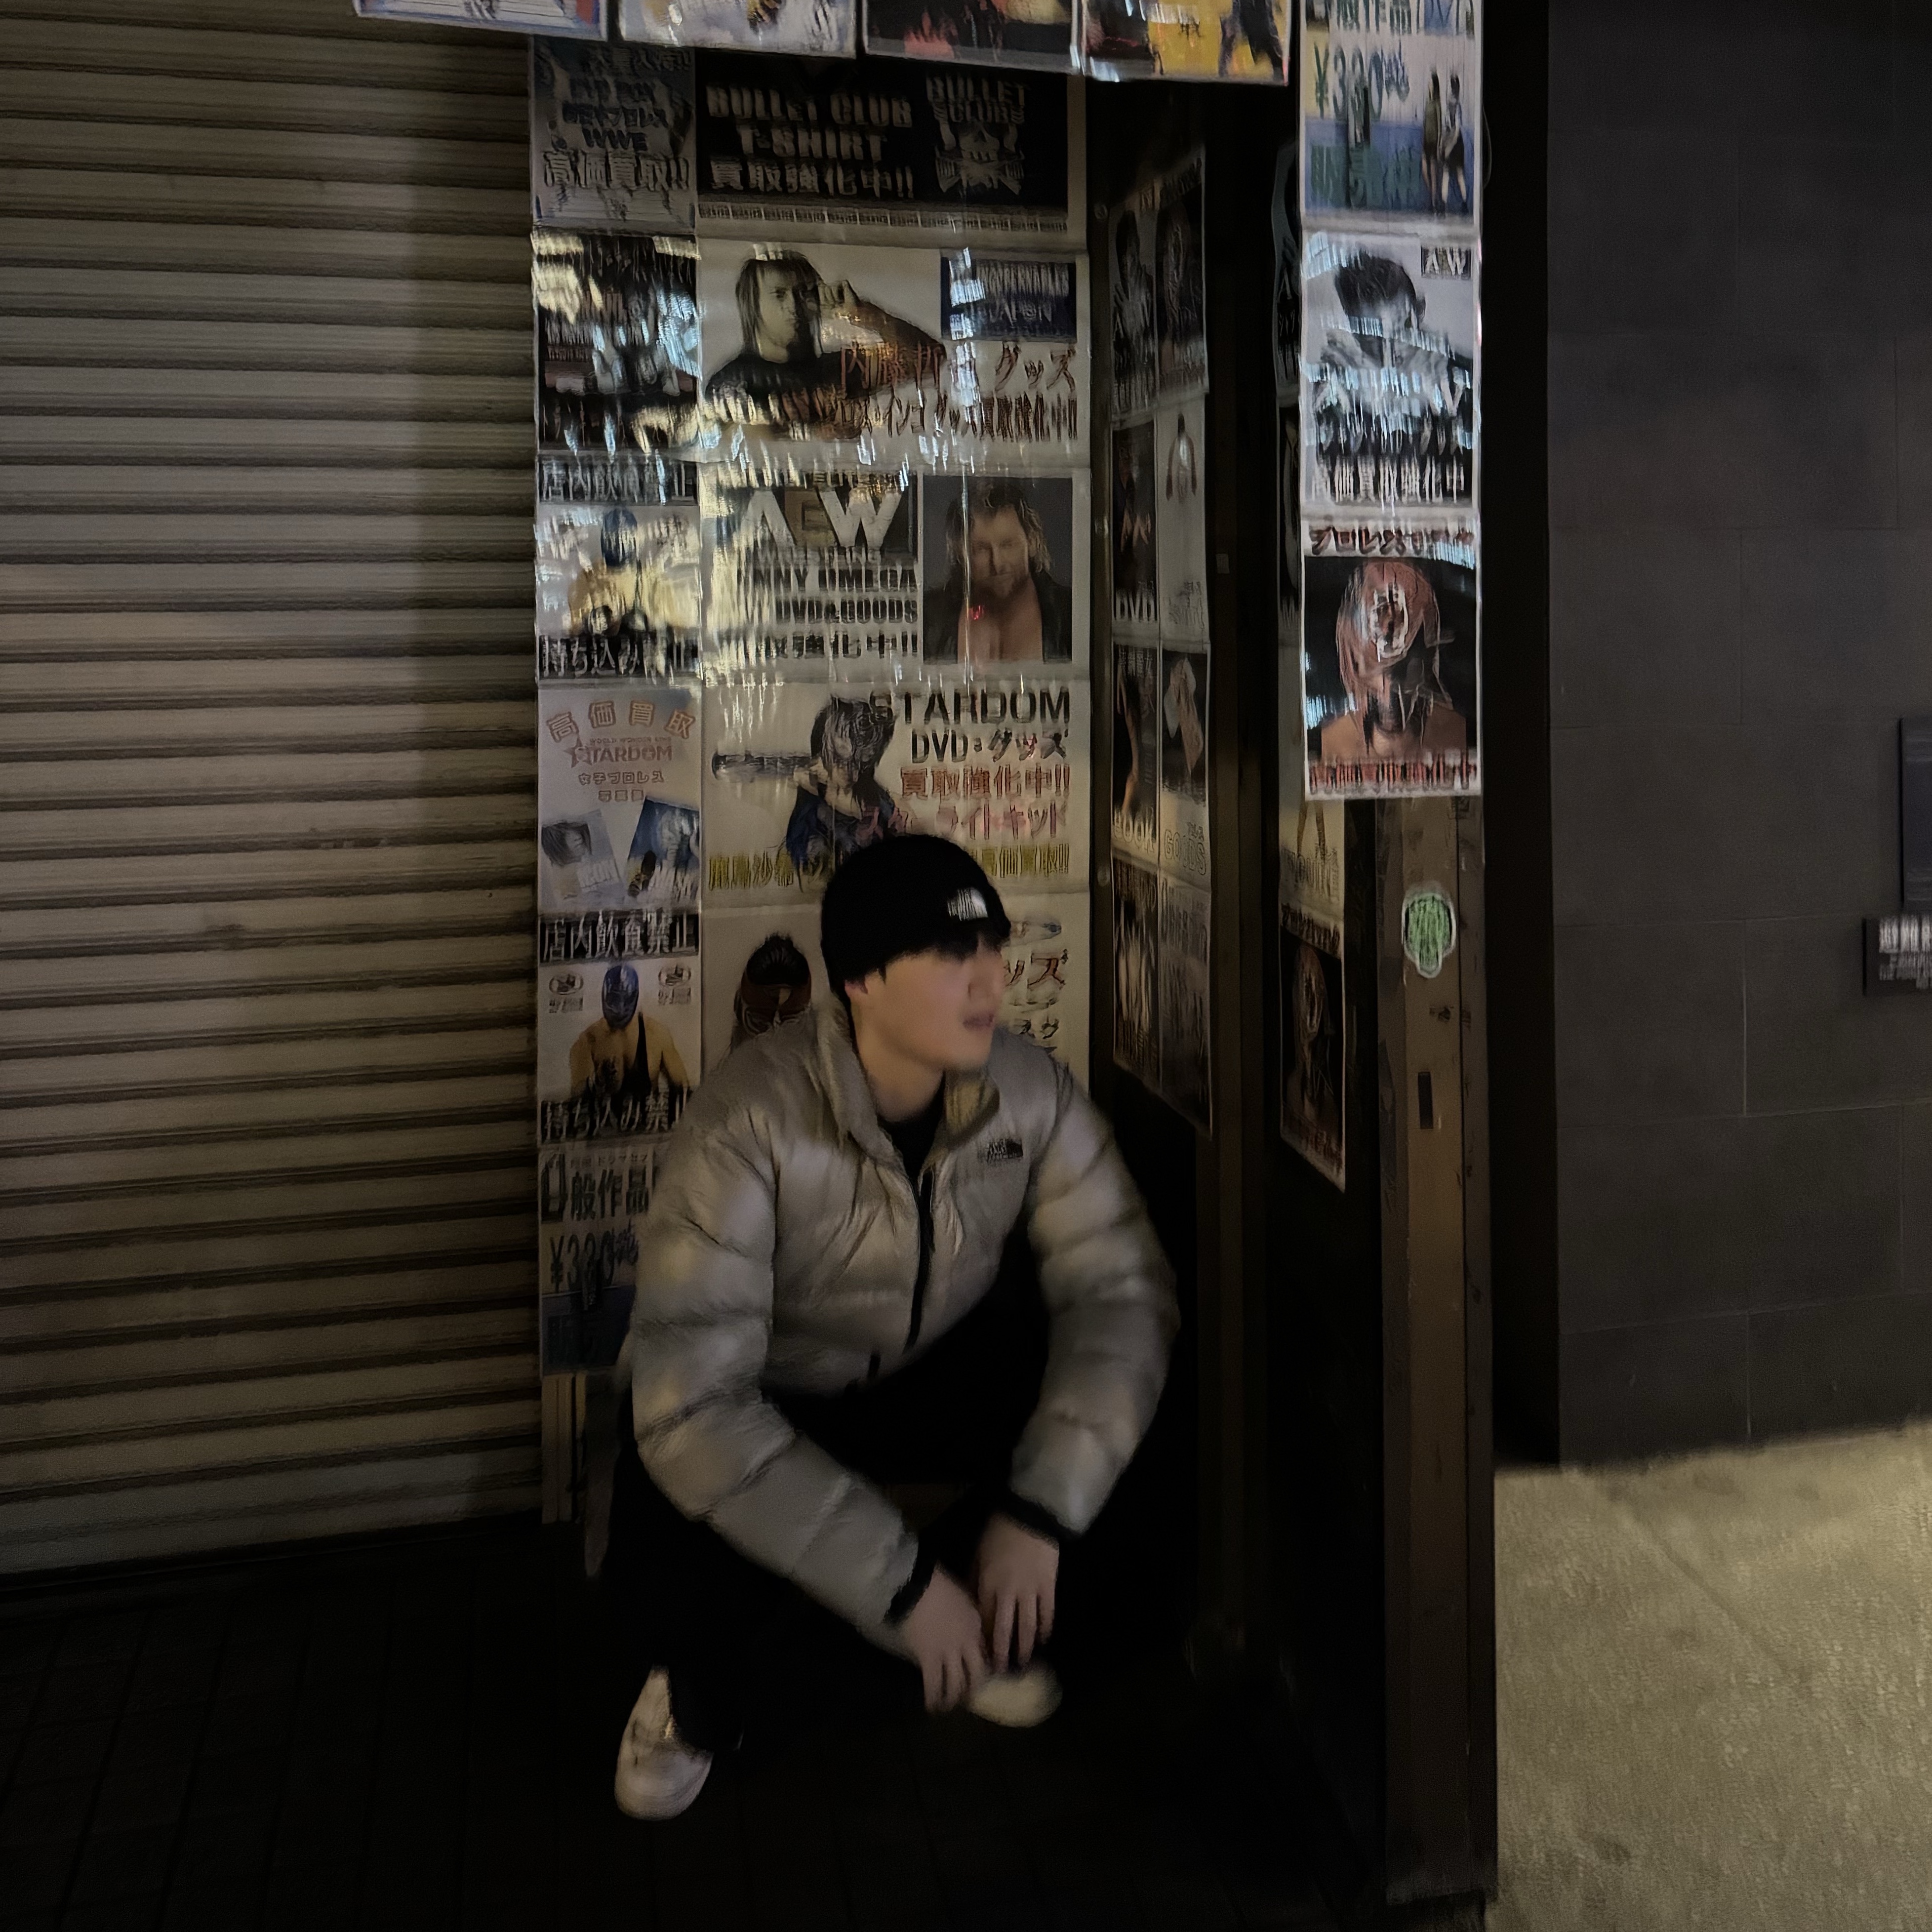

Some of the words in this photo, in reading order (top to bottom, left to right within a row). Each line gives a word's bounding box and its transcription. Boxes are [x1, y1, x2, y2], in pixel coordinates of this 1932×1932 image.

[547, 700, 695, 743] 高価買取
[869, 688, 1070, 725] STARDOM
[578, 770, 664, 786] 女子プロレス
